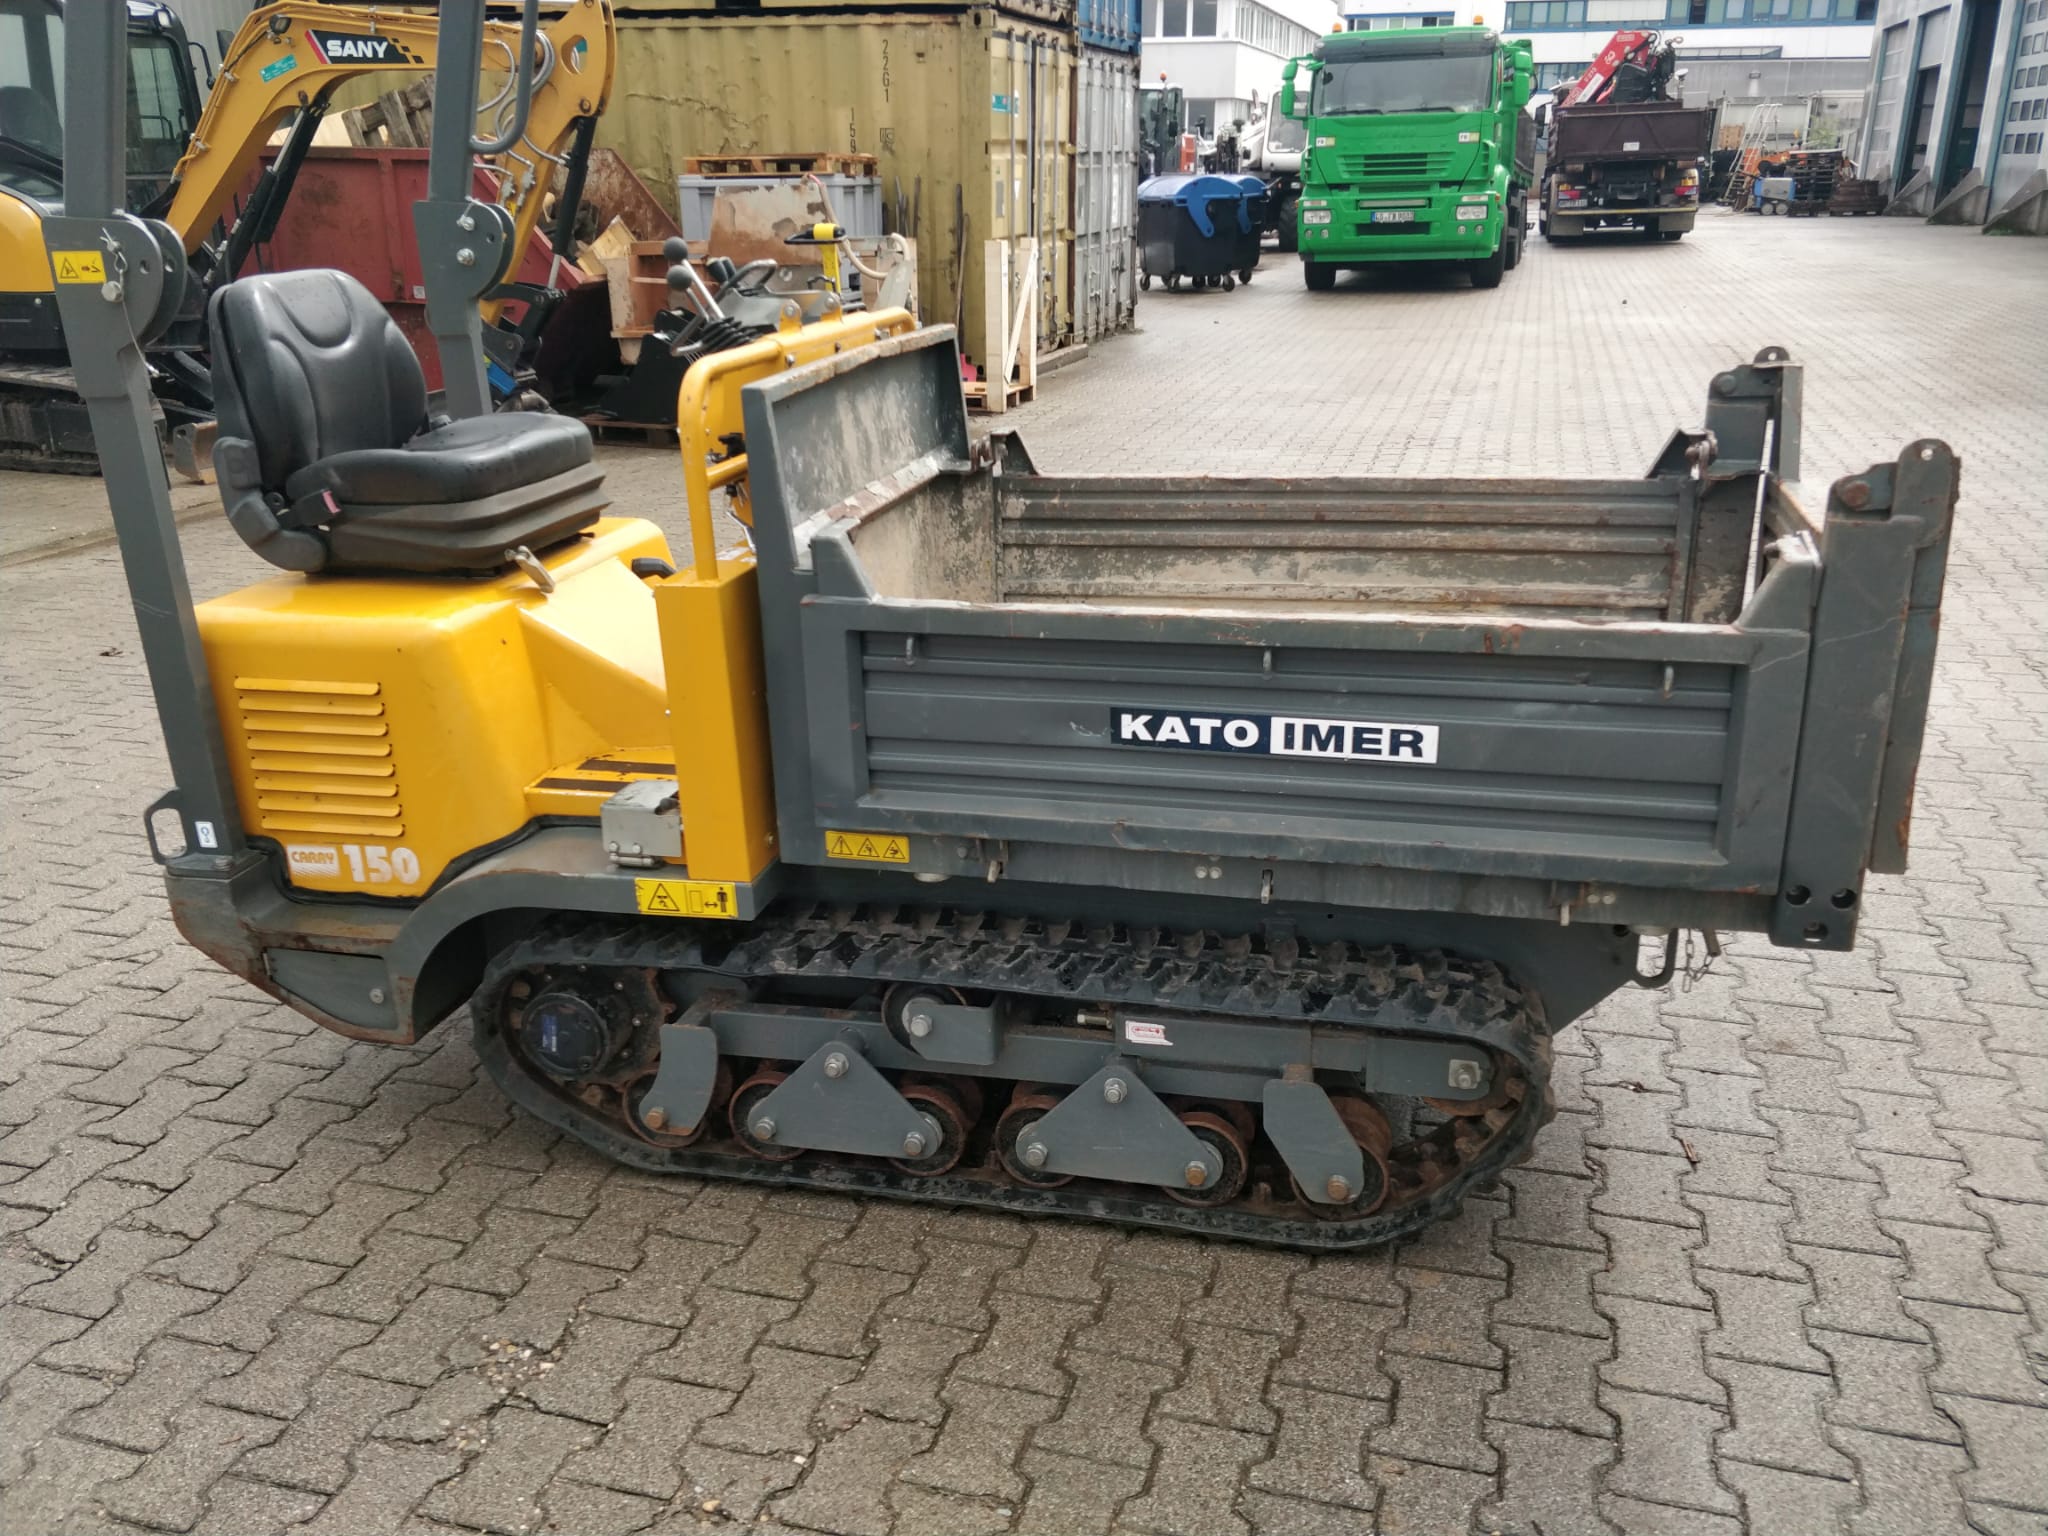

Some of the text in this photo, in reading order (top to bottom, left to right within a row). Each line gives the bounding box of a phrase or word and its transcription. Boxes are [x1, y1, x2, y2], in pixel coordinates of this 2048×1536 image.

[326, 39, 388, 58] SANY
[881, 38, 891, 104] 22G1
[1121, 713, 1424, 758] KATO IMER
[291, 843, 421, 885] CARRY 150
